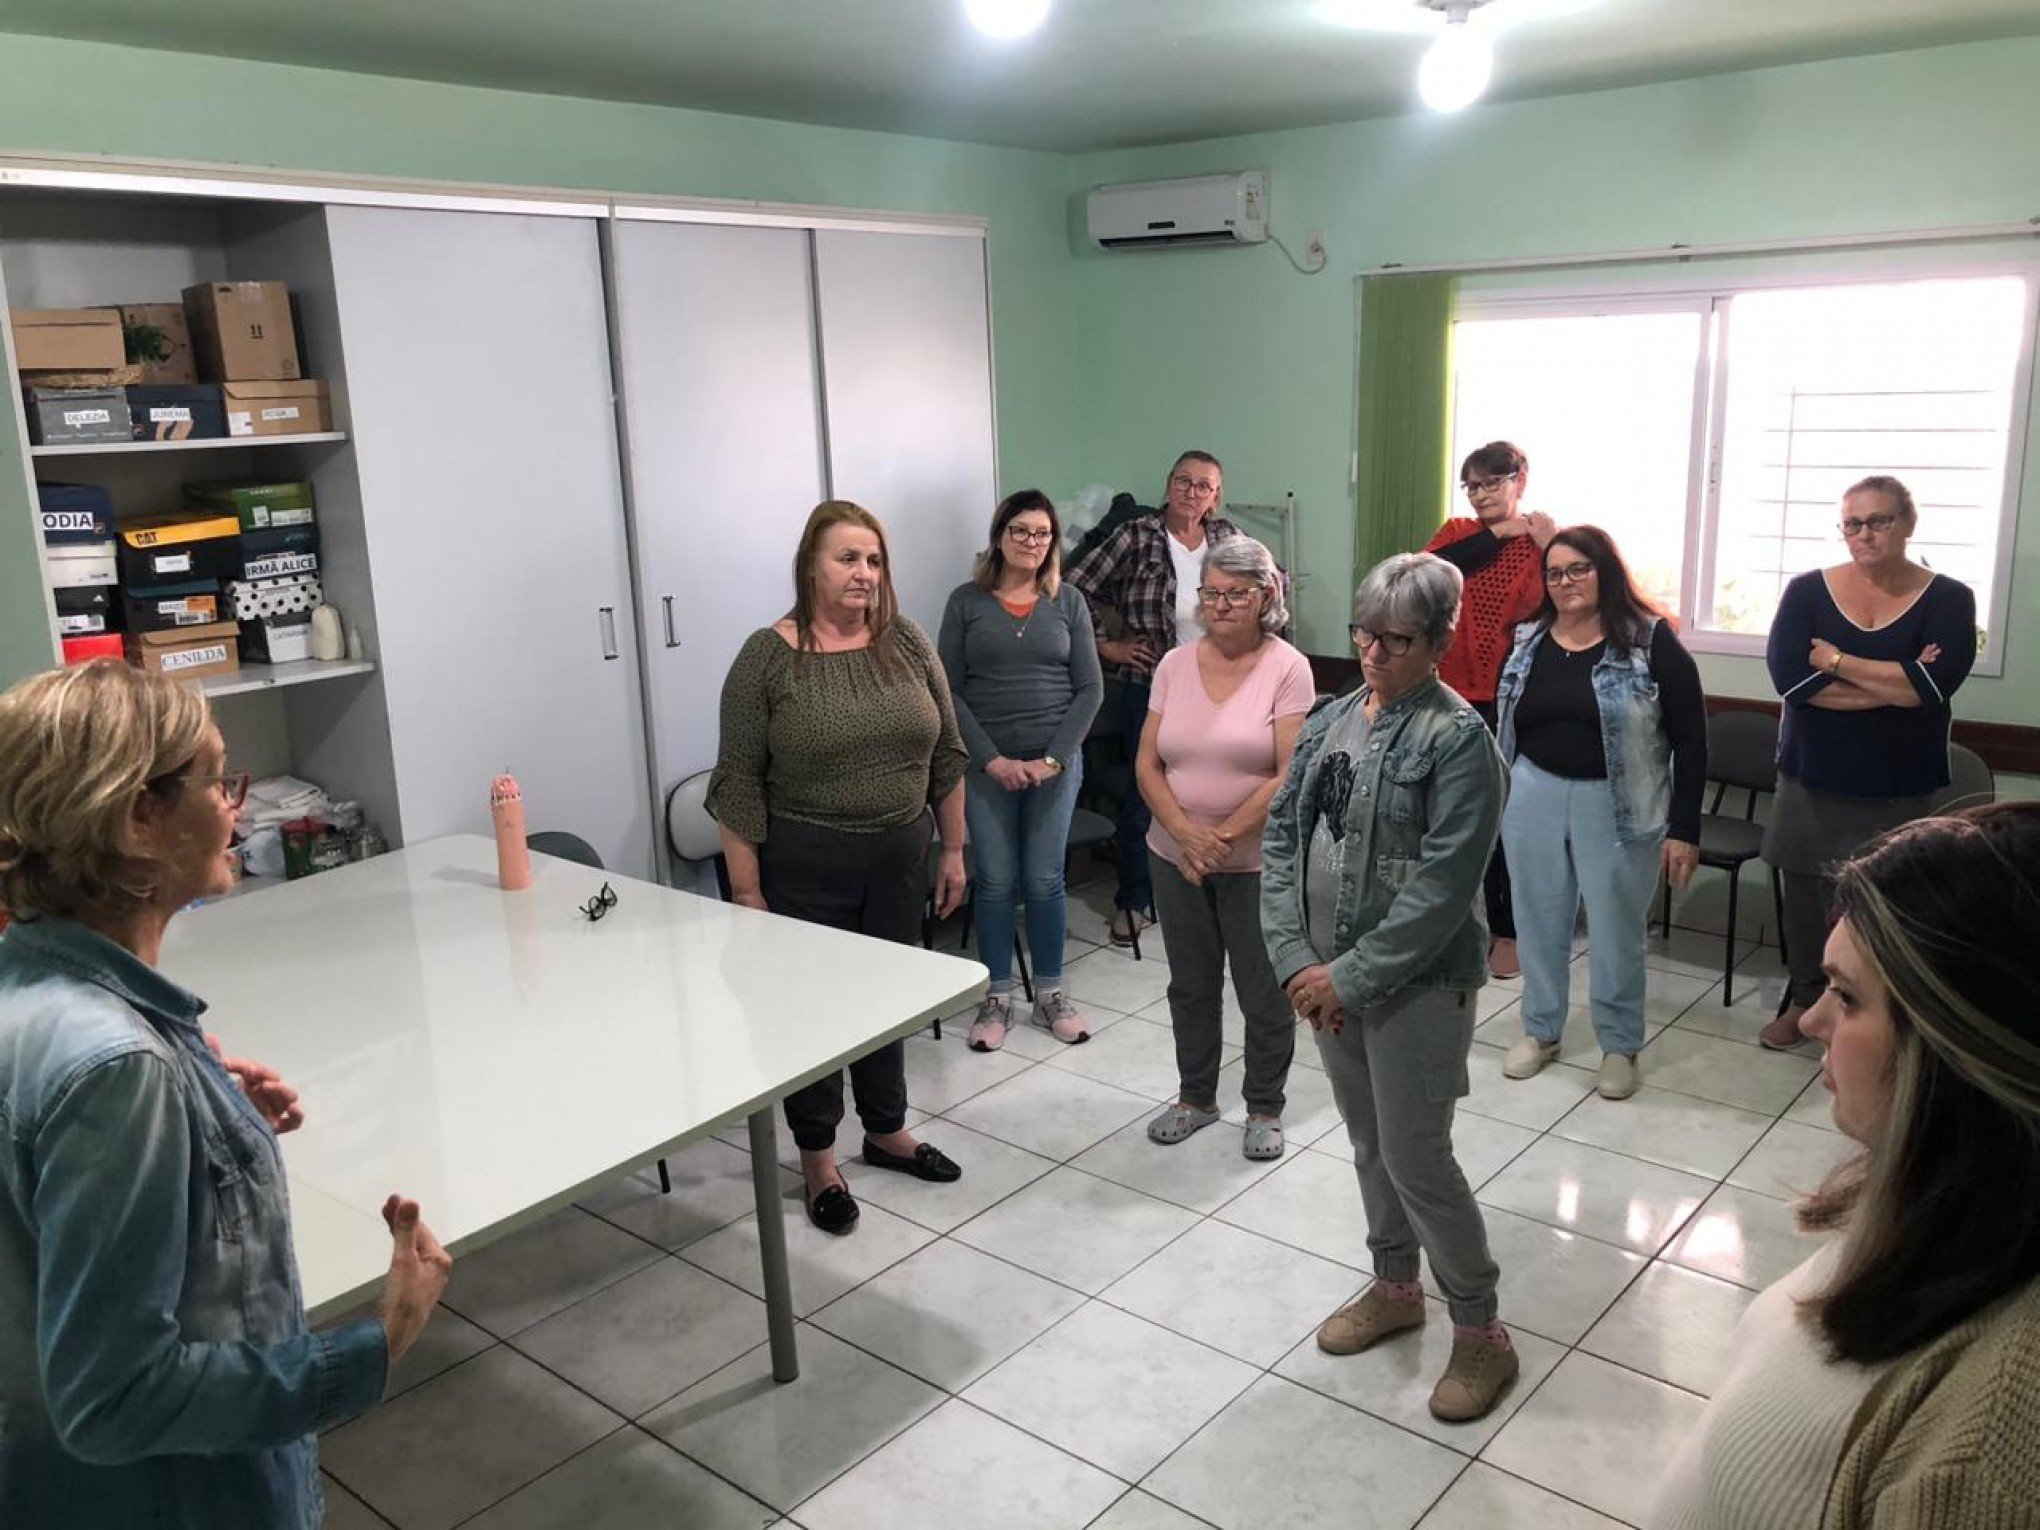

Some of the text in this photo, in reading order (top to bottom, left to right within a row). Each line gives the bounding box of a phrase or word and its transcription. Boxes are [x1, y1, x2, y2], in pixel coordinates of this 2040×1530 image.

[135, 531, 156, 545] CAT
[281, 557, 316, 573] ALICE
[161, 647, 225, 667] CENILDA
